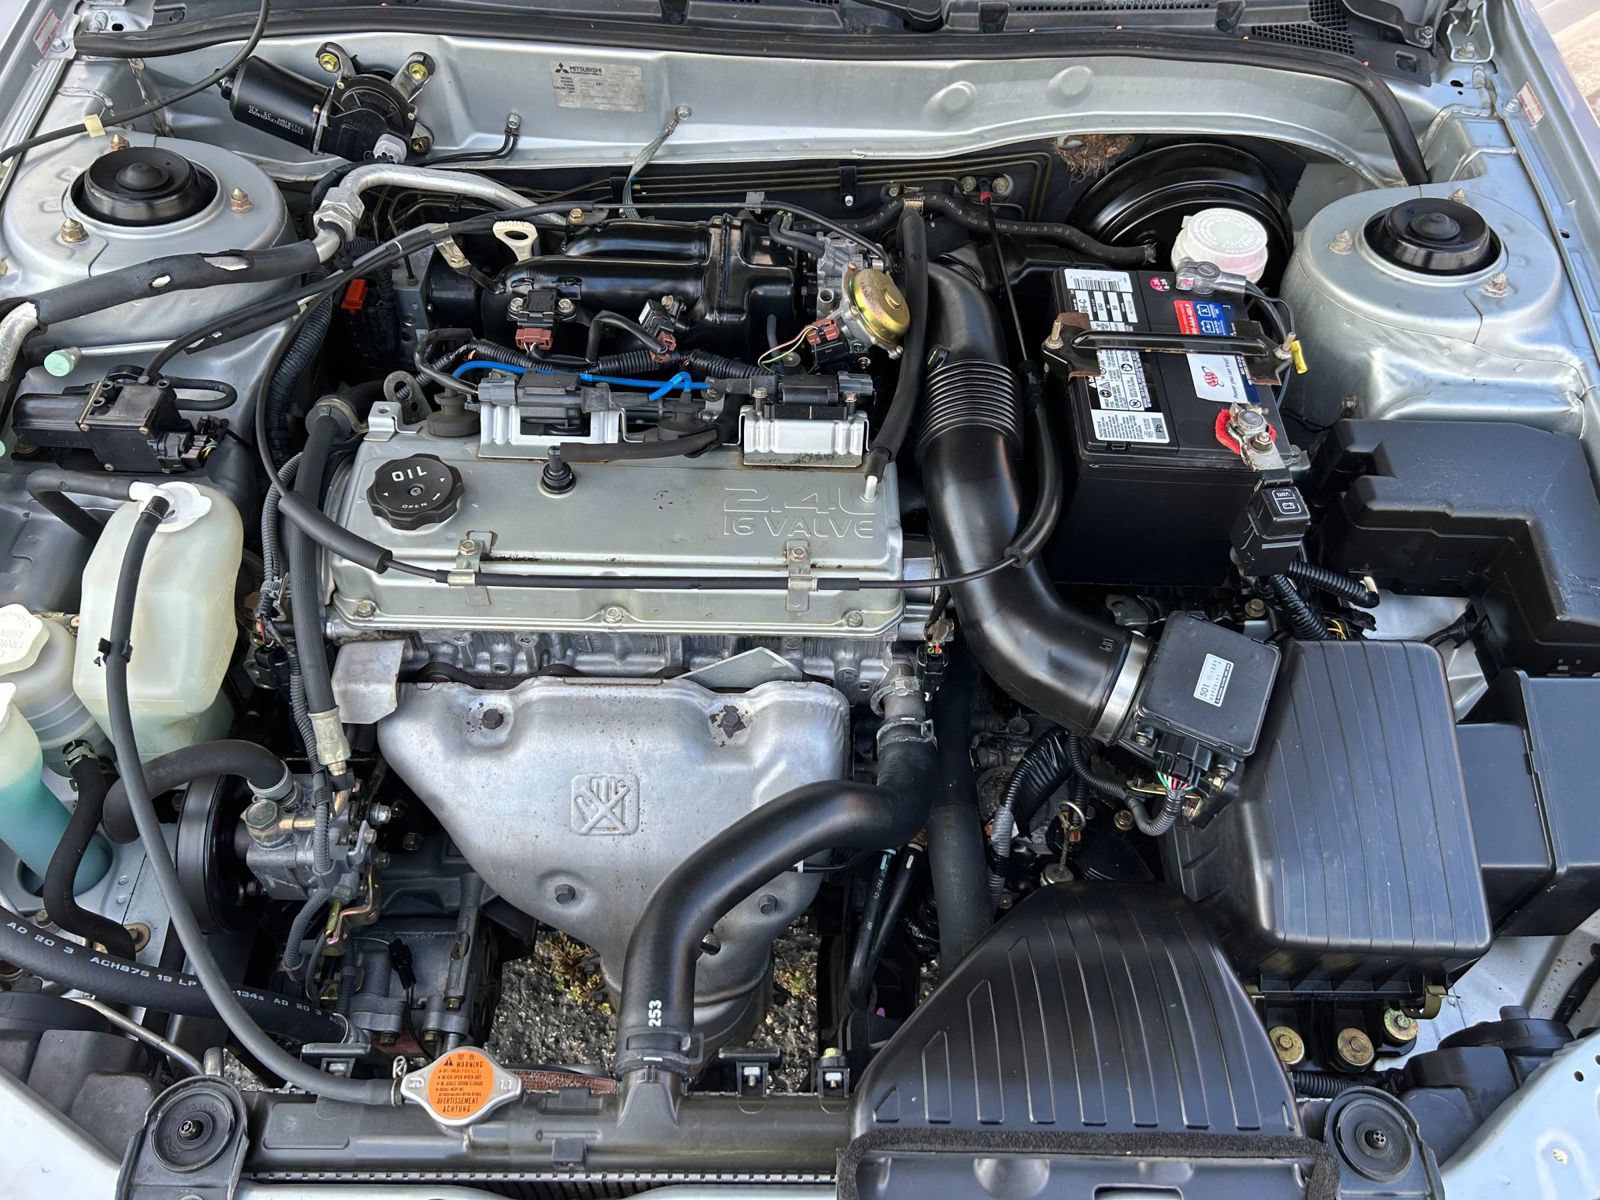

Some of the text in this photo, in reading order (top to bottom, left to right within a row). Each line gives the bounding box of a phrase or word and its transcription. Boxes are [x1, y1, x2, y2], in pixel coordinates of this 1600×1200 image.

[391, 465, 428, 482] OIL
[723, 485, 877, 516] 2.4L
[723, 515, 875, 539] 16 VALVE
[6, 920, 28, 935] AD
[33, 934, 56, 948] 20
[62, 946, 75, 955] 3
[178, 978, 198, 987] LP
[273, 997, 289, 1006] AD
[648, 999, 663, 1027] 253
[456, 1060, 484, 1068] WARNING
[500, 1079, 512, 1090] 1.1
[436, 1097, 480, 1105] AVERTISSEMENT
[442, 1105, 472, 1113] ACHTUNG
